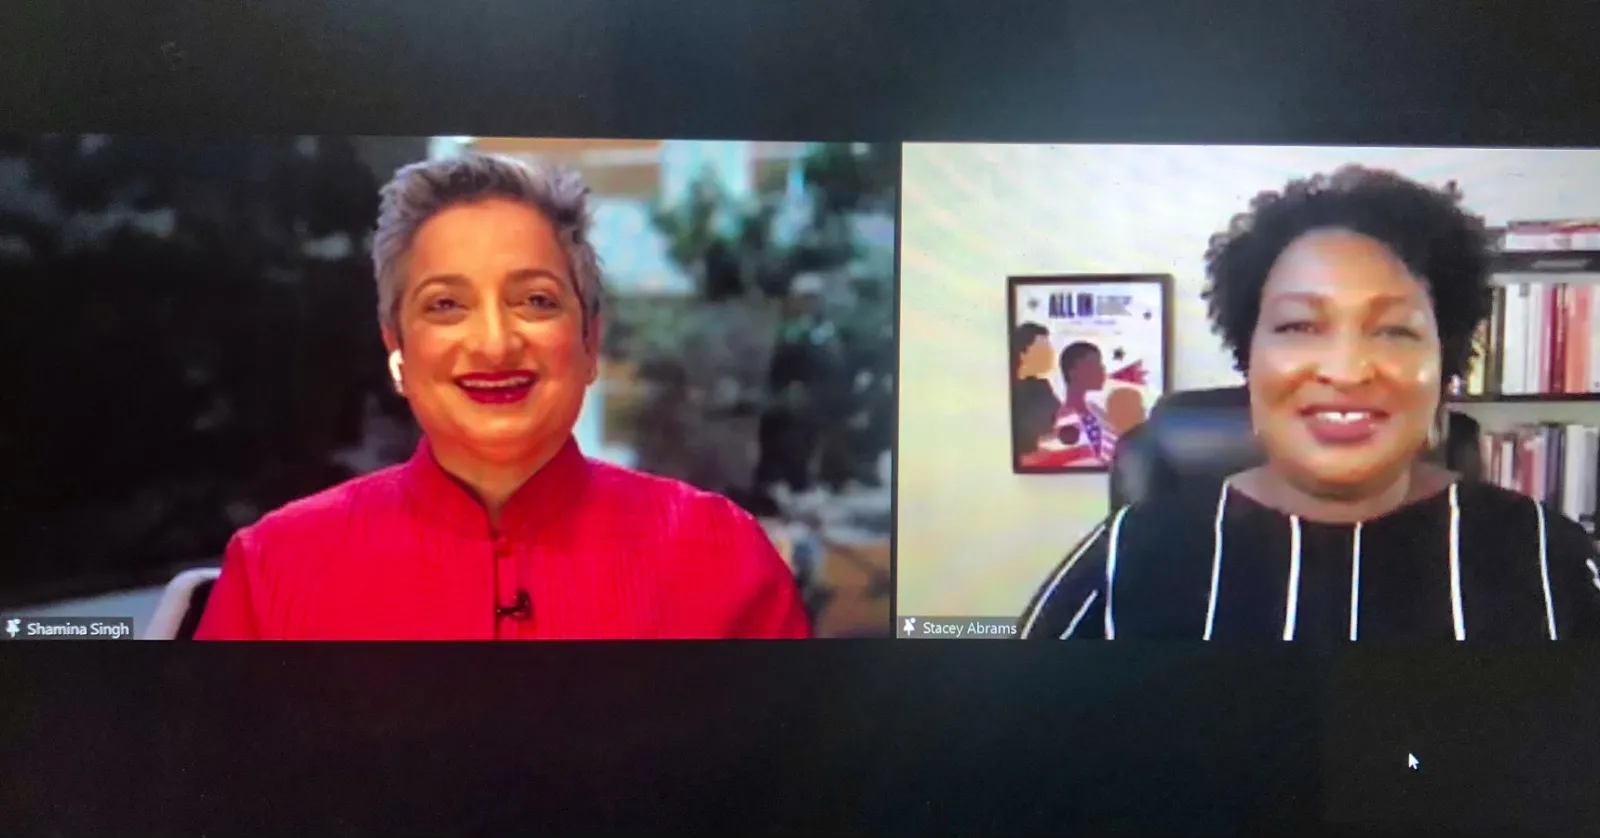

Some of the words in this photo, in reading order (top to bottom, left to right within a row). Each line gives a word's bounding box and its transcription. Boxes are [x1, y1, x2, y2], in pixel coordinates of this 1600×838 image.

[1048, 292, 1075, 318] ALL
[27, 622, 88, 635] Shamina
[90, 622, 130, 639] Singh
[923, 621, 964, 638] Stacey
[967, 621, 1018, 635] Abrams
